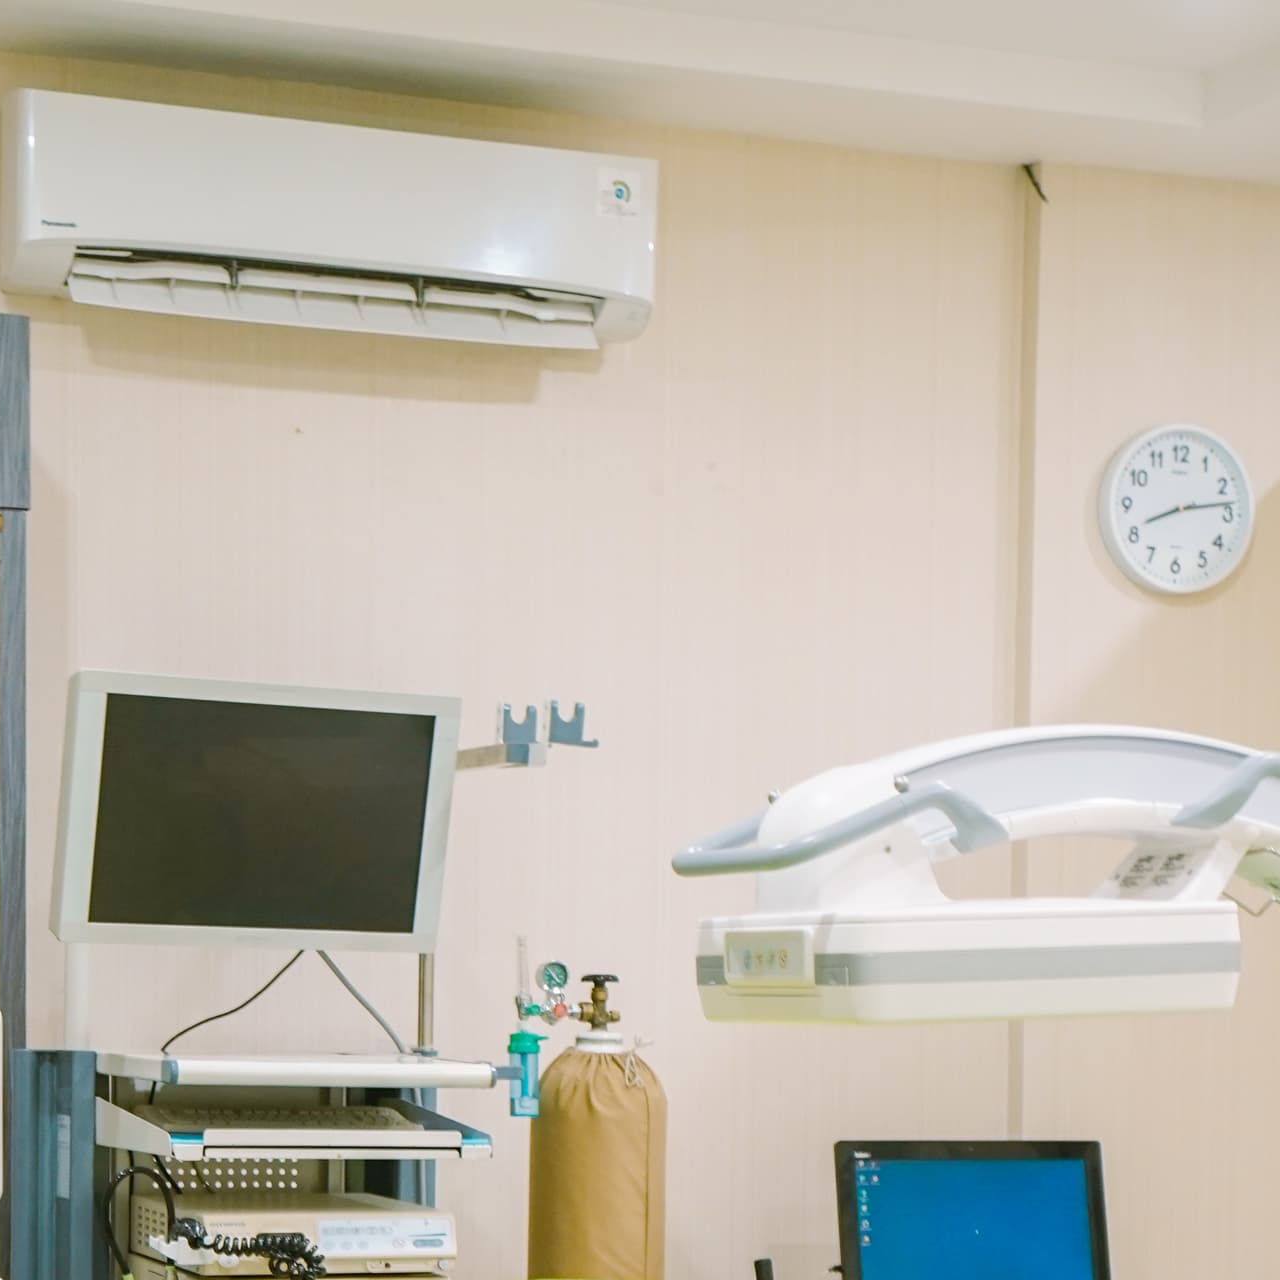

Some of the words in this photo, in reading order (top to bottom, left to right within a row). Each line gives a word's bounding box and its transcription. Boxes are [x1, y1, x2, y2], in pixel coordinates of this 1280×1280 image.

[1150, 451, 1163, 468] 11
[1173, 445, 1190, 463] 12
[1202, 456, 1209, 473] 1
[1130, 469, 1148, 487] 10
[1218, 478, 1227, 495] 2
[1121, 496, 1133, 513] 9
[1222, 505, 1233, 523] 3
[1128, 526, 1139, 543] 8
[1212, 534, 1223, 551] 4
[1146, 546, 1155, 563] 7
[1197, 551, 1207, 568] 5
[1170, 556, 1181, 574] 6
